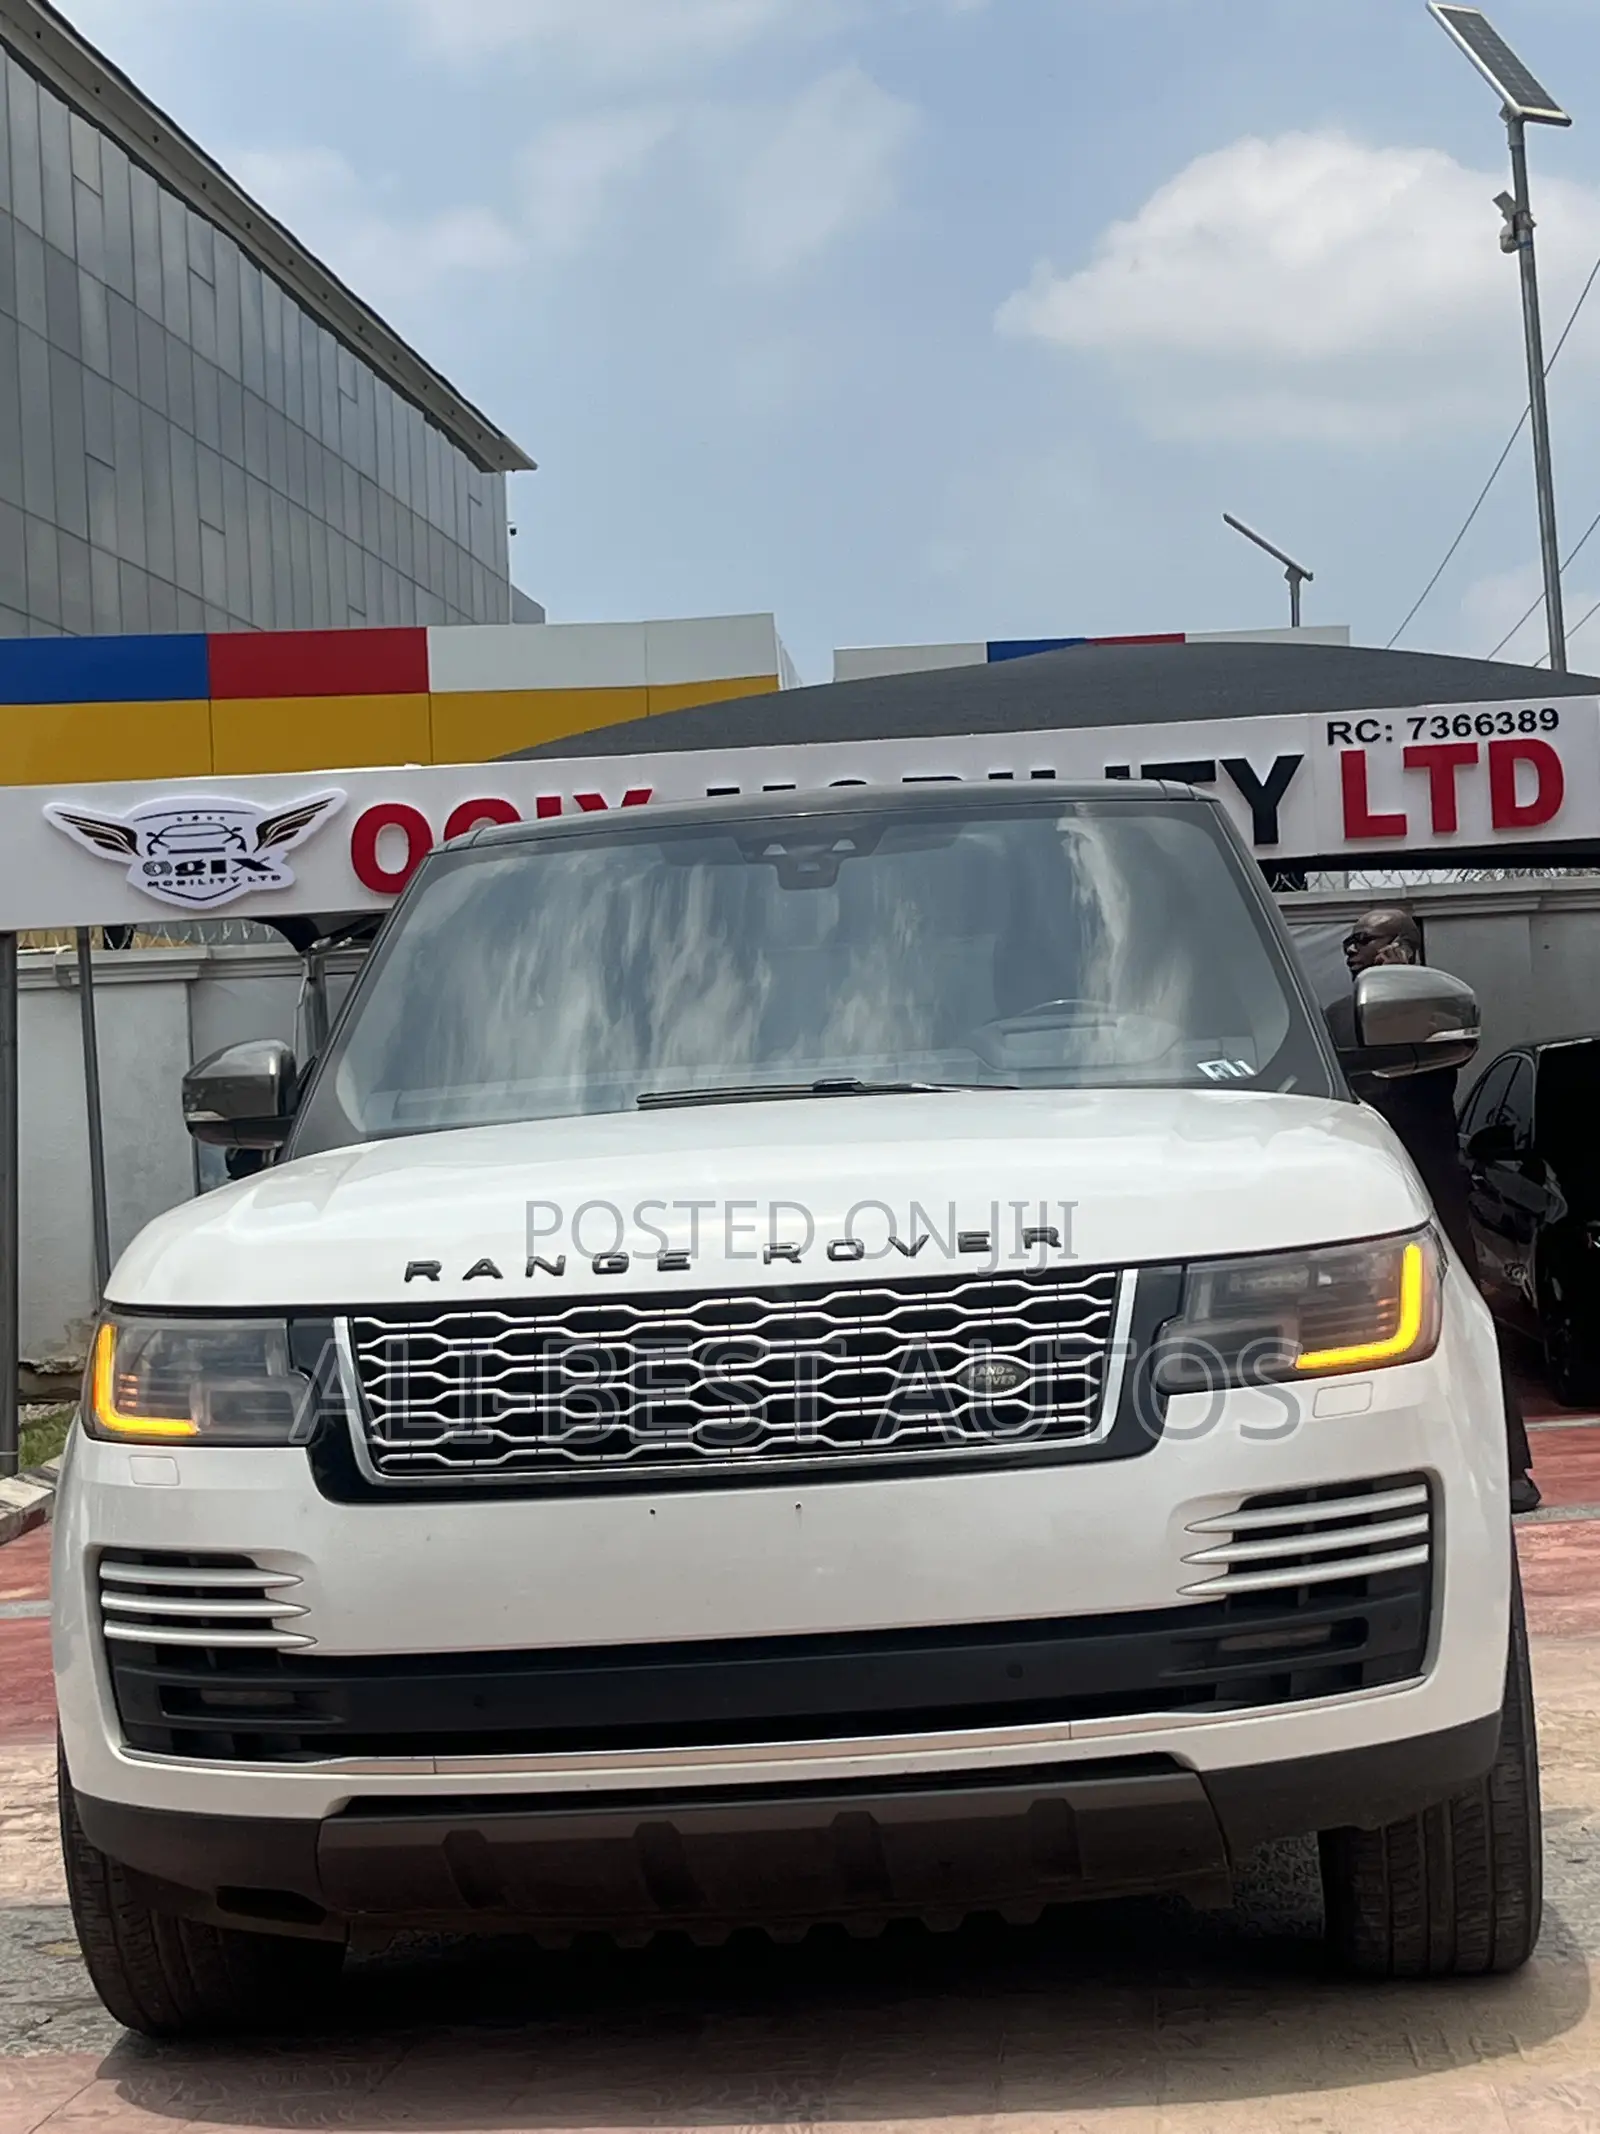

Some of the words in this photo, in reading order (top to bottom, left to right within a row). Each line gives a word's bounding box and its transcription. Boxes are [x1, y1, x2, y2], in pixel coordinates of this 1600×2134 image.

[1327, 719, 1393, 745] RC:
[1407, 708, 1560, 740] 7366389
[1341, 738, 1564, 839] LTD
[147, 876, 240, 887] MOBILITY
[247, 874, 281, 882] LTD
[404, 1250, 692, 1282] RANGE
[762, 1226, 1062, 1265] ROVER
